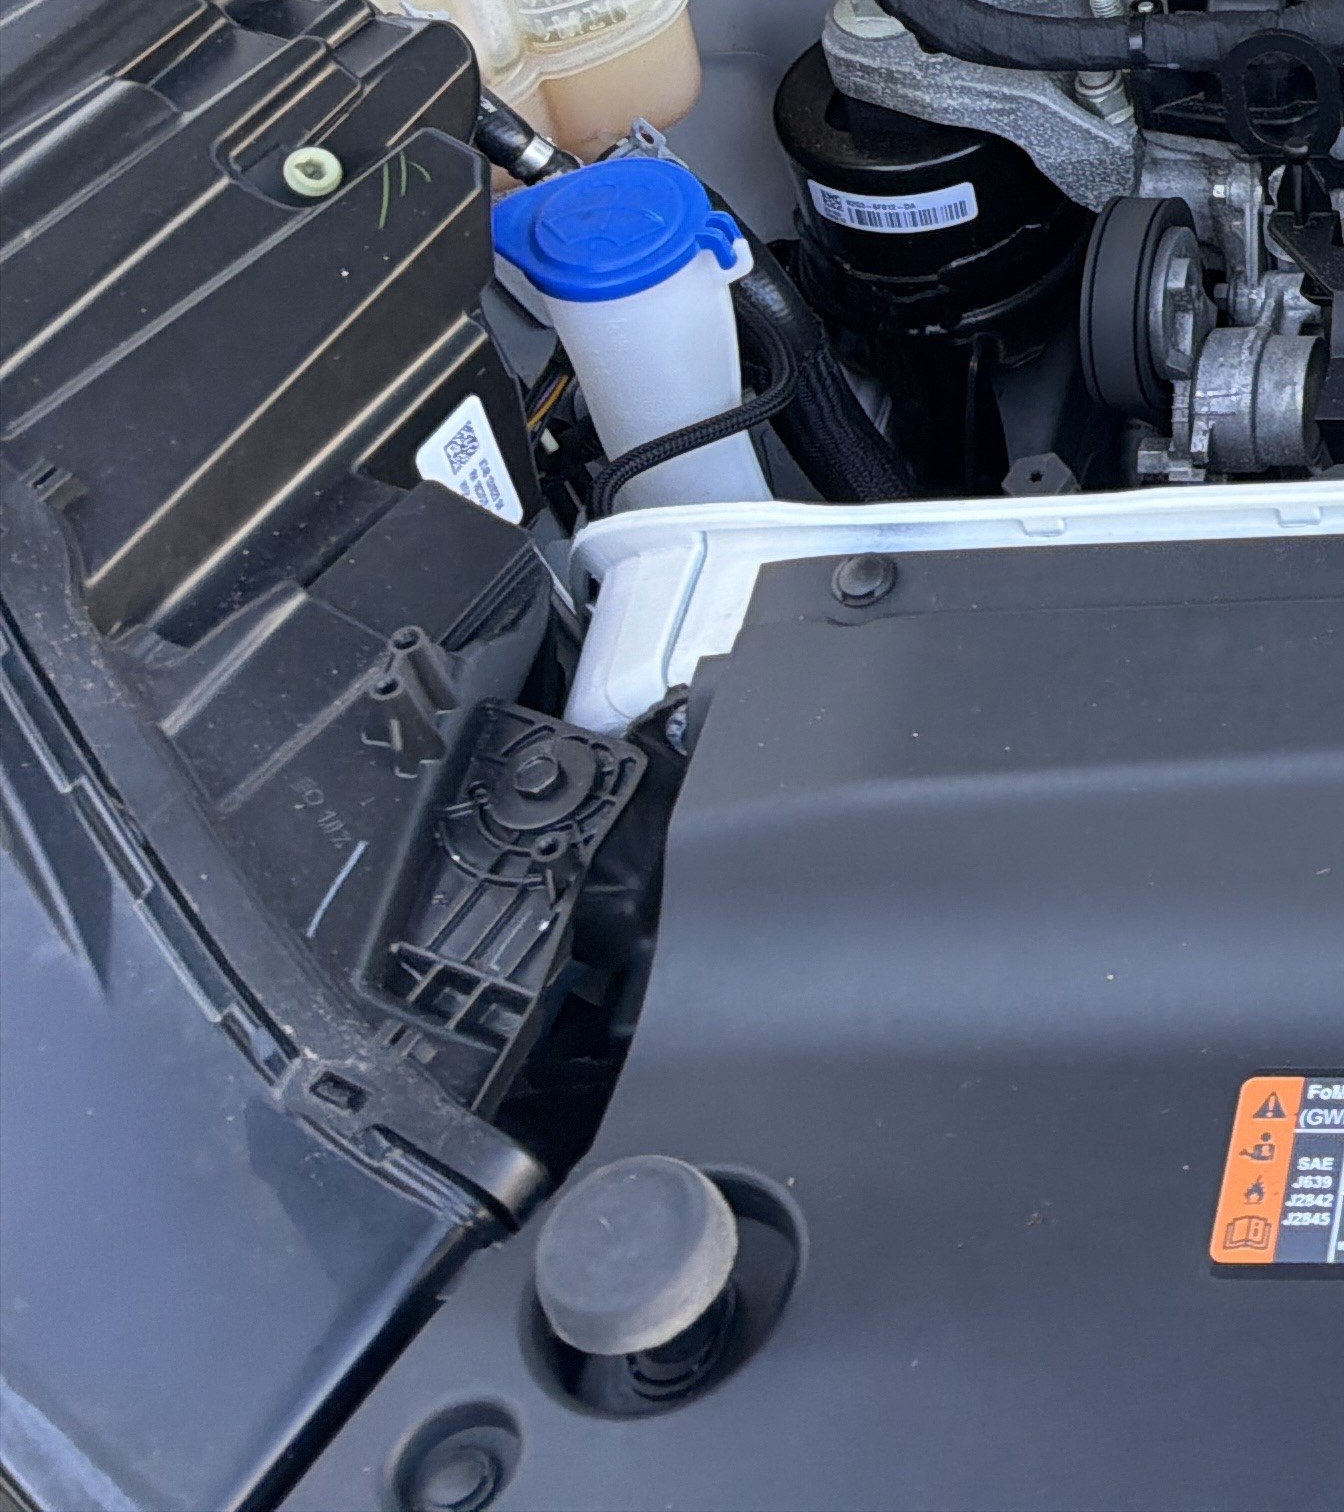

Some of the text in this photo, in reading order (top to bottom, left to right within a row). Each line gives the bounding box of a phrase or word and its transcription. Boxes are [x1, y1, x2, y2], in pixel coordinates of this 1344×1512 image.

[1297, 1156, 1334, 1171] SAE
[1291, 1175, 1333, 1188] J639
[1285, 1194, 1334, 1207] J2842
[1281, 1212, 1331, 1226] J2845
